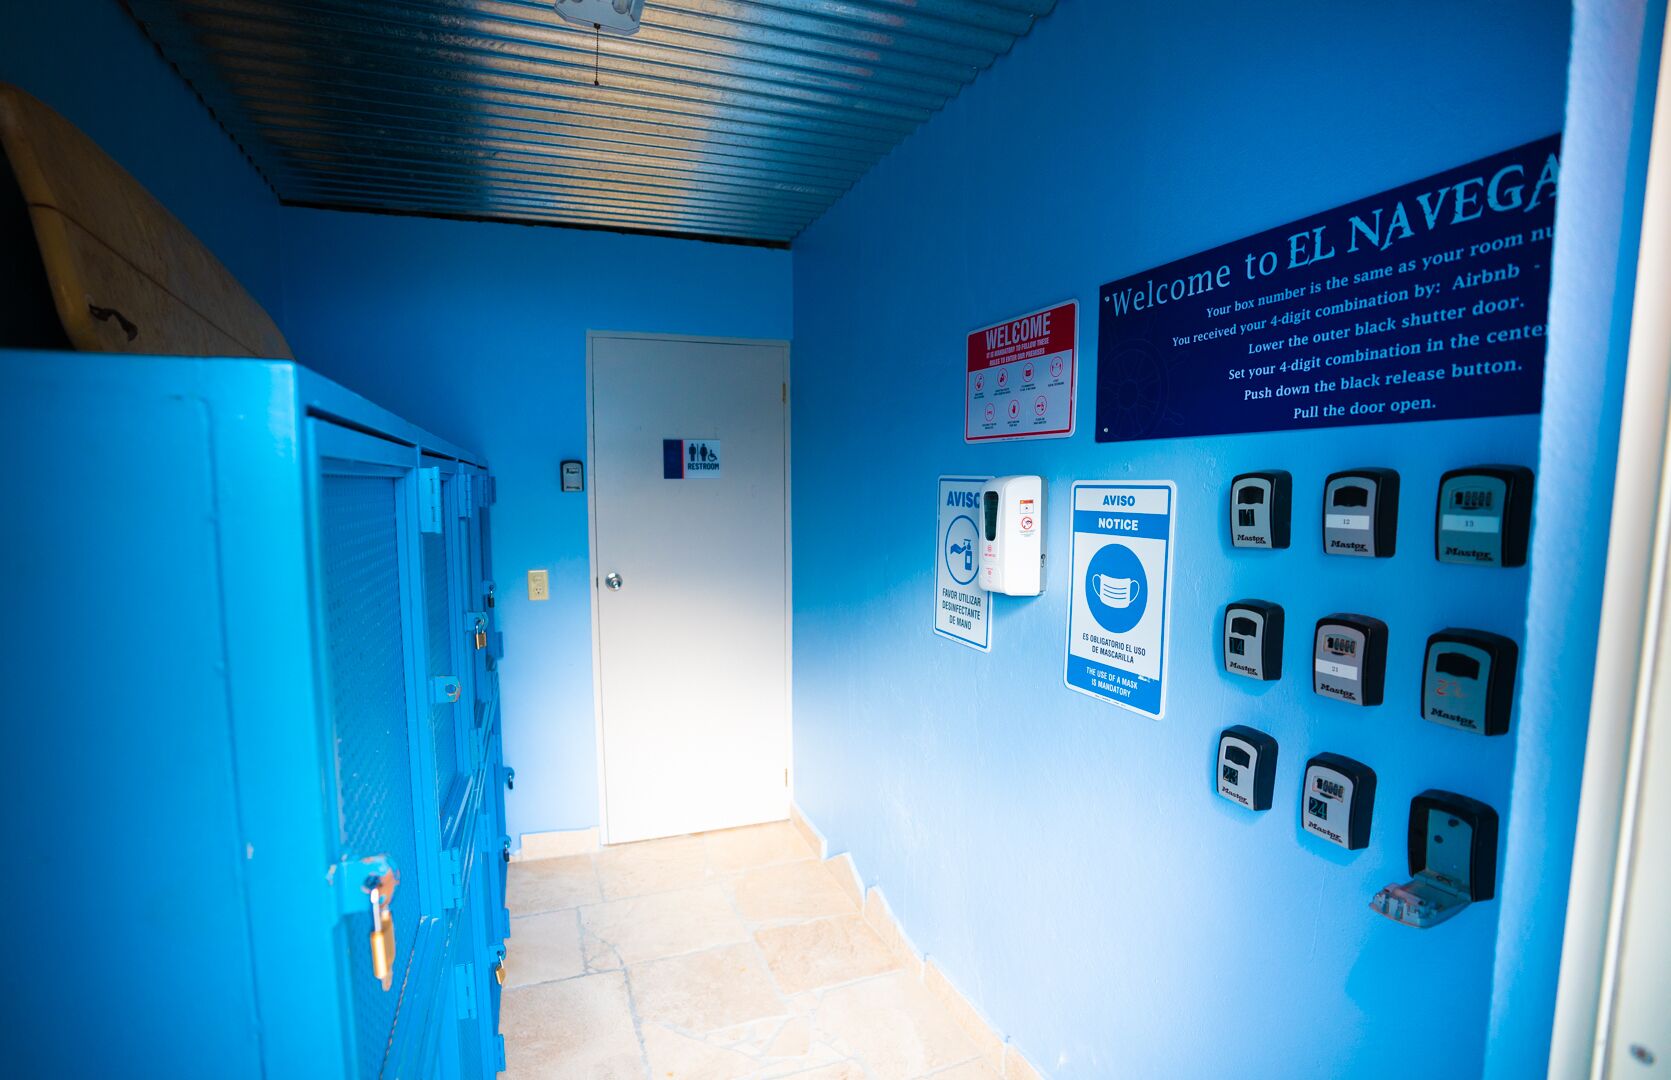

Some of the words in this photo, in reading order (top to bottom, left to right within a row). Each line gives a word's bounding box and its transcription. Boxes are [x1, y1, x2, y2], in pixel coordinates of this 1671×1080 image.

[1111, 264, 1231, 317] Welcome
[1245, 251, 1278, 280] to
[1287, 225, 1336, 269] EL
[1206, 304, 1232, 318] Your
[1234, 299, 1255, 312] box
[1258, 285, 1306, 306] number
[1310, 281, 1322, 294] is
[1326, 276, 1349, 291] the
[1353, 265, 1393, 284] same
[1398, 259, 1416, 274] as
[1422, 247, 1465, 270] your
[1470, 231, 1524, 257] room
[1172, 336, 1191, 347] You
[1193, 323, 1237, 344] received
[1240, 318, 1267, 336] your
[1270, 308, 1311, 327] 4-digit
[1315, 287, 1409, 318] combination
[1414, 282, 1441, 302] by:
[1452, 263, 1520, 290] Airbnb
[985, 312, 1052, 351] WELCOME
[1248, 340, 1285, 354] Lower
[1288, 334, 1310, 348] the
[1313, 327, 1351, 343] outer
[1355, 317, 1397, 336] black
[1401, 305, 1467, 328] shutter
[1472, 296, 1525, 316] door.
[1228, 369, 1246, 380] Set
[1249, 363, 1276, 379] your
[1279, 355, 1321, 372] 4-digit
[1325, 341, 1421, 367] combination
[1426, 337, 1444, 352] in
[1450, 333, 1480, 349] the
[1244, 388, 1272, 401] Push
[1276, 385, 1310, 398] down
[1314, 379, 1336, 392] the
[1340, 373, 1381, 390] black
[1385, 366, 1446, 385] release
[1451, 358, 1523, 378] button.
[1293, 405, 1319, 419] Pull
[1323, 403, 1346, 417] the
[1350, 400, 1386, 415] door
[1390, 398, 1437, 415] open.
[687, 462, 720, 470] RESTROOM
[1102, 494, 1136, 507] AVISO
[1098, 517, 1139, 531] NOTICE
[1237, 534, 1265, 542] Master
[1330, 540, 1366, 549] Master
[1445, 547, 1491, 559] Master
[942, 587, 958, 600] FAVOR
[958, 592, 982, 608] UTILIZAR
[942, 600, 981, 620] DESINFECTANTE
[949, 614, 957, 625] DE
[957, 616, 972, 631] MANO
[1082, 632, 1089, 641] ES
[1090, 634, 1125, 650] OBLIGATORIO
[1125, 643, 1133, 653] EL
[1133, 646, 1146, 657] USO
[1091, 645, 1099, 654] DE
[1099, 647, 1135, 664] MASCARILLA
[1229, 661, 1257, 673] Master
[1086, 666, 1096, 676] THE
[1096, 669, 1107, 680] USE
[1108, 673, 1115, 682] OF
[1116, 676, 1121, 684] A
[1121, 677, 1138, 690] MASK
[1091, 678, 1097, 687] IS
[1097, 680, 1131, 698] MANDATORY
[1320, 683, 1355, 697] Master
[1430, 708, 1474, 725] Master
[1221, 786, 1248, 802] Master
[1309, 797, 1327, 819] 24
[1307, 820, 1342, 839] Master
